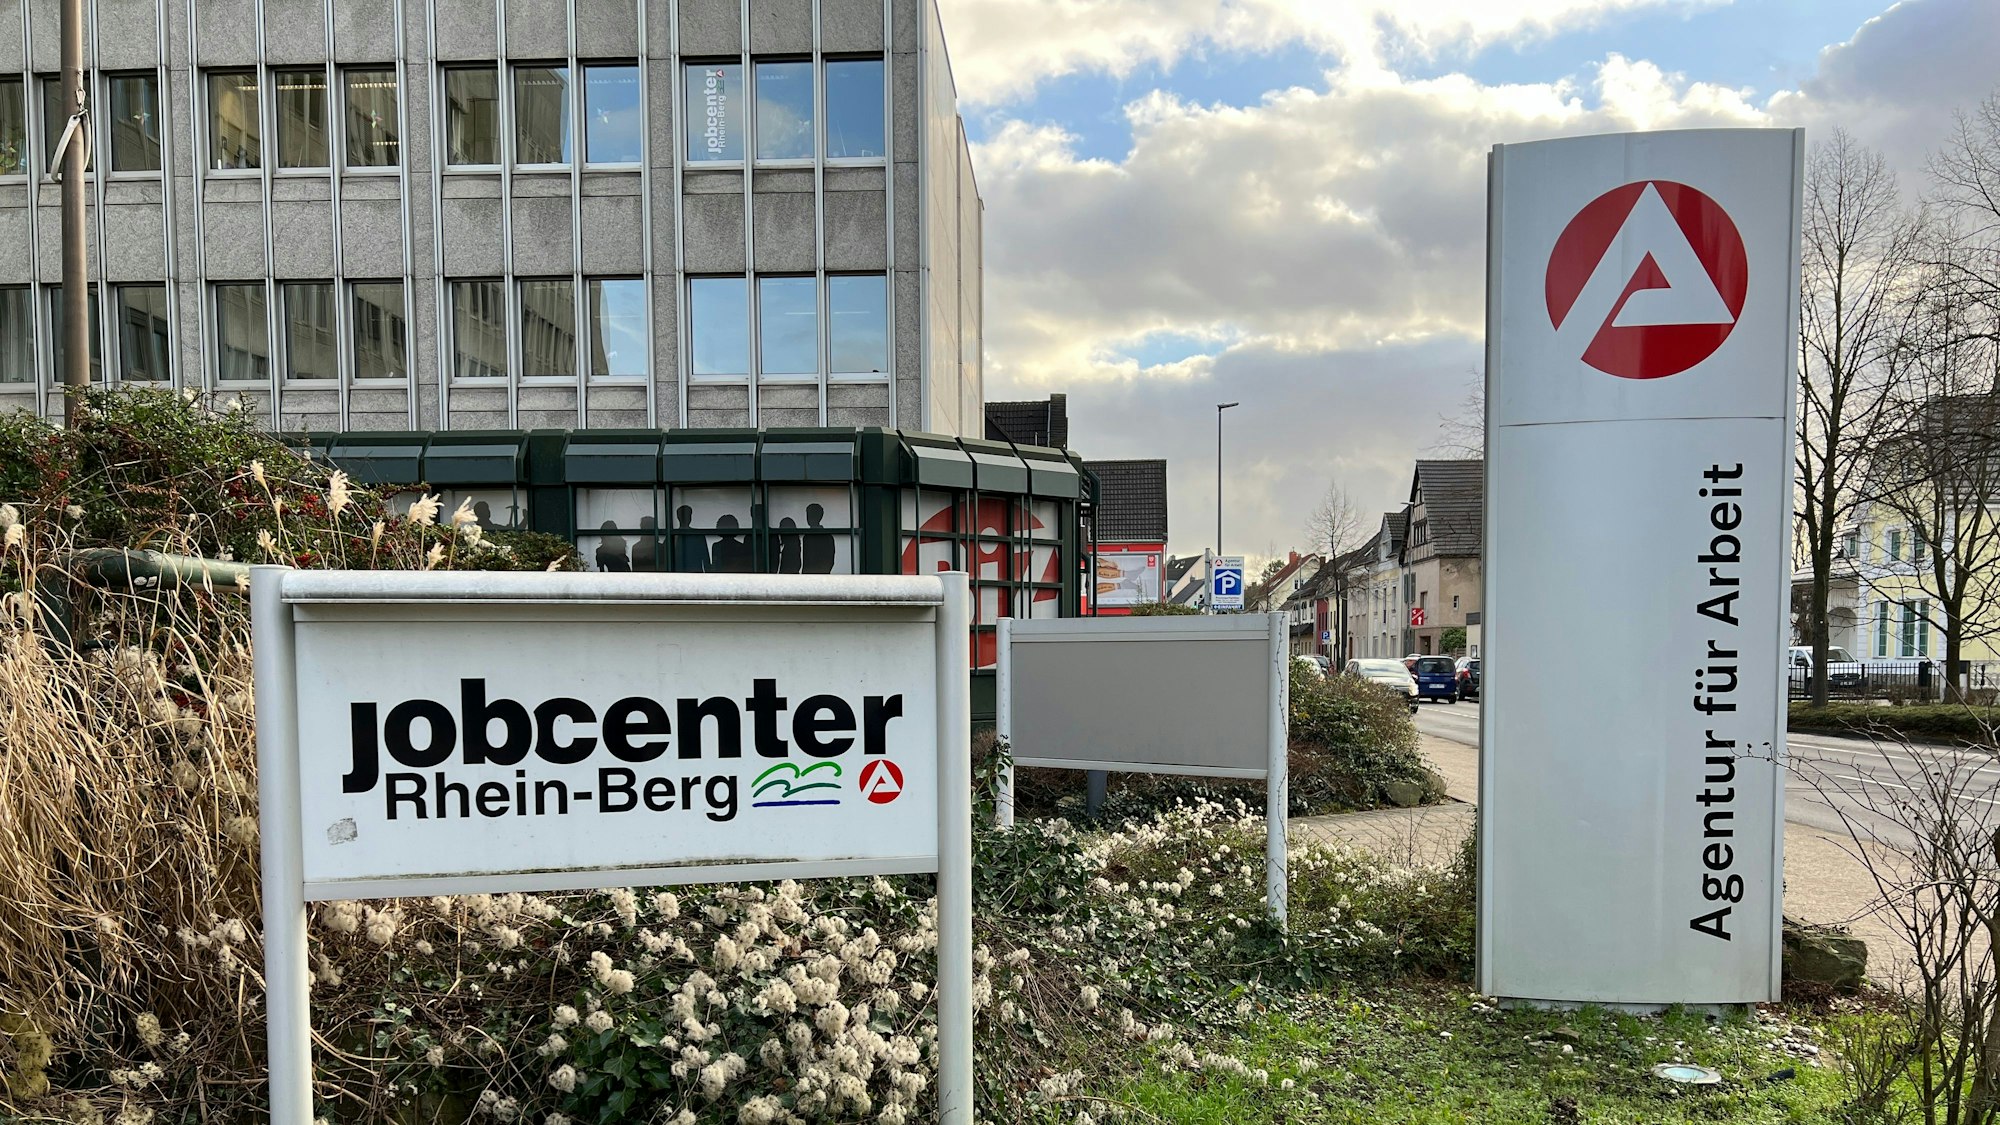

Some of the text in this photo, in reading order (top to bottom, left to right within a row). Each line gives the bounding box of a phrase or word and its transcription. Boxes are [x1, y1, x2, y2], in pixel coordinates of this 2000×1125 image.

[704, 69, 721, 154] jobcenter
[717, 95, 727, 148] Rhein-Berg
[1222, 577, 1235, 594] P
[343, 678, 903, 794] jobcenter
[1690, 463, 1744, 942] Agentur für Arbeit
[385, 767, 738, 822] Rhein-Berg
